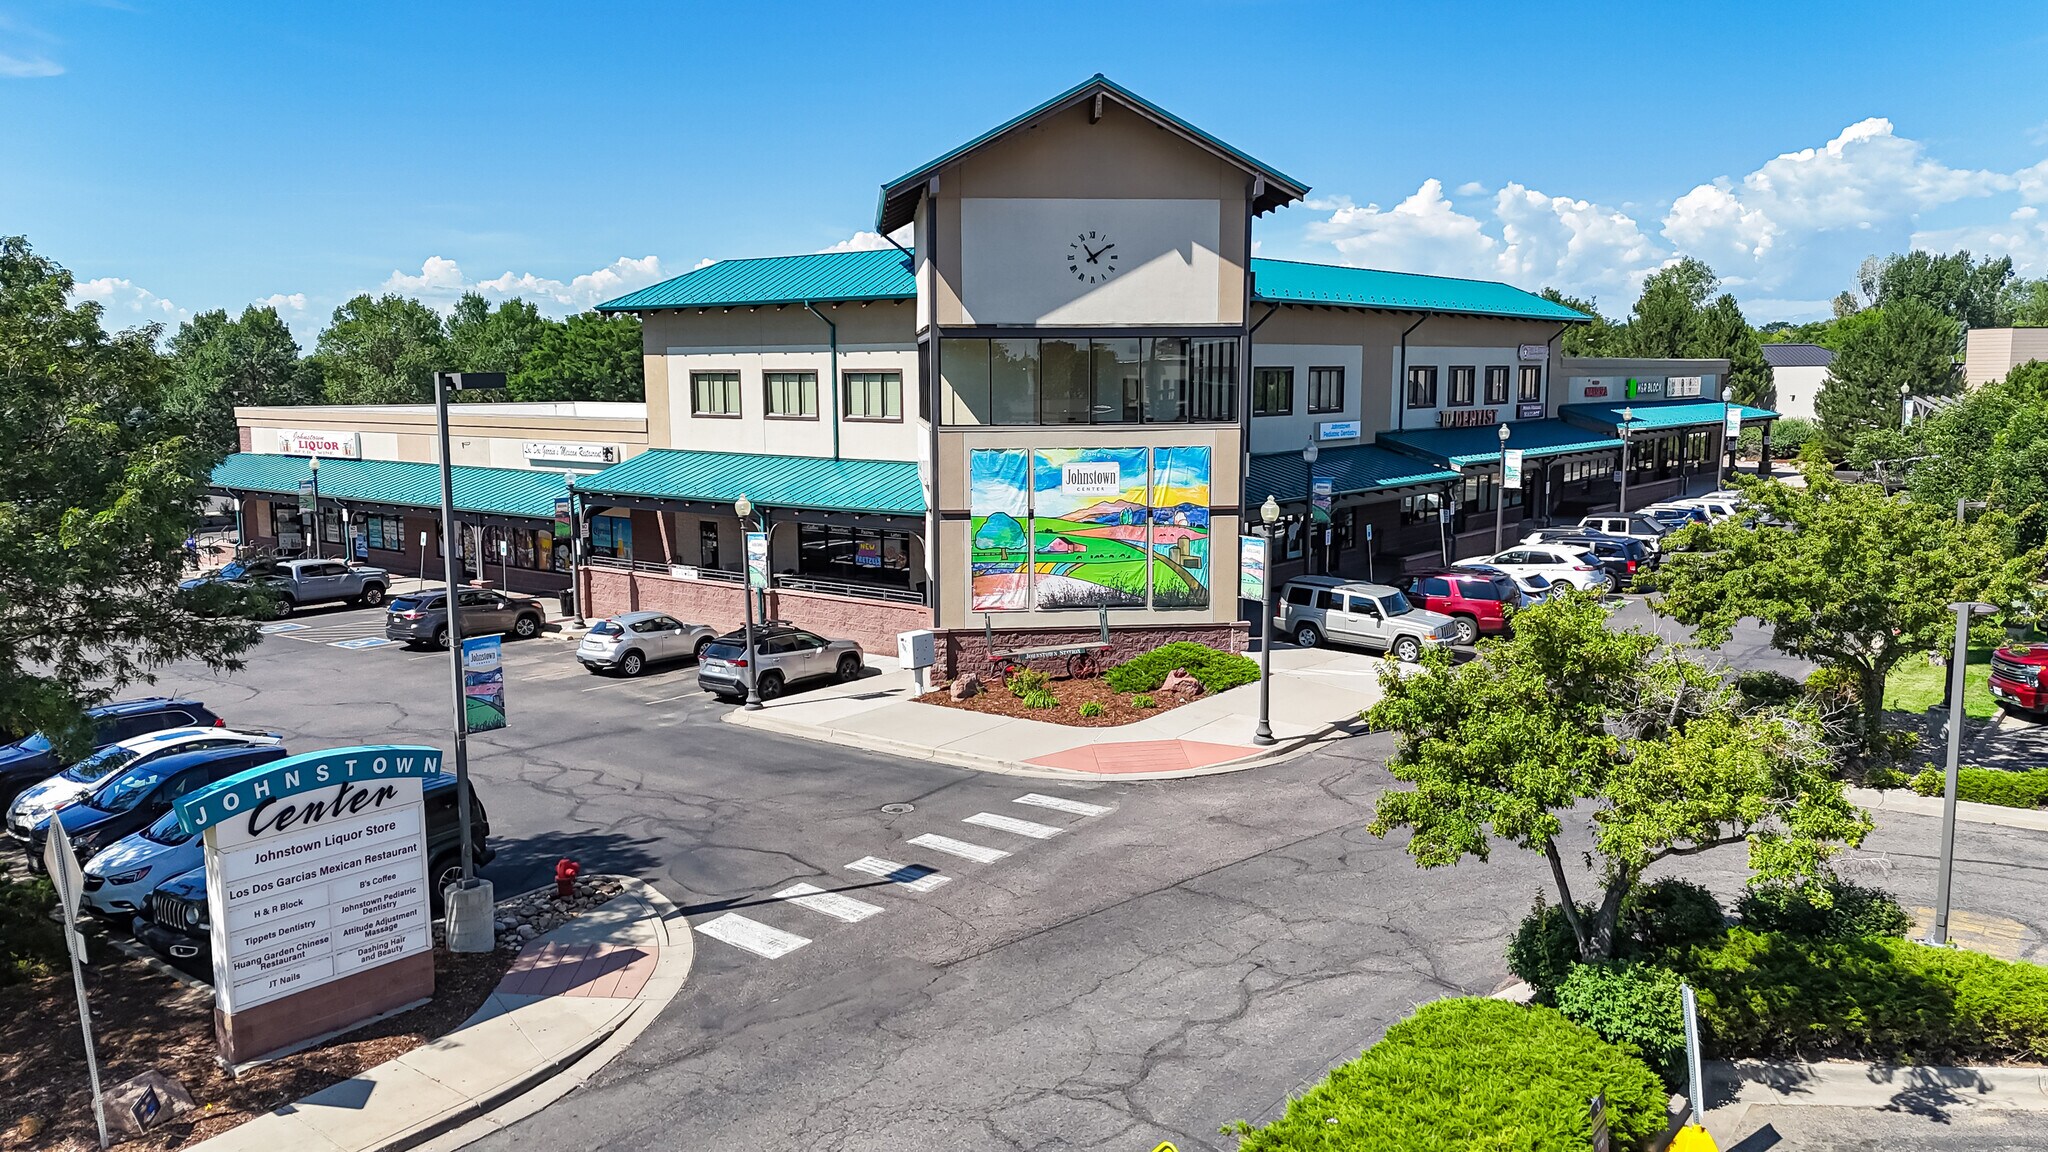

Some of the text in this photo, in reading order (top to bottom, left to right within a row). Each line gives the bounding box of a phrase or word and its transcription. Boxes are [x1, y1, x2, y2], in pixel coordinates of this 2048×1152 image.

[1455, 409, 1498, 427] DENTIST
[293, 431, 325, 442] Johnstown
[298, 440, 339, 452] LIQUOR
[1065, 469, 1116, 485] Johnstown
[860, 543, 875, 551] NEW
[471, 651, 496, 663] Johnstown
[195, 756, 438, 826] JOHNSTOWN
[248, 781, 398, 837] Center
[254, 820, 396, 865] Johnstown Liquor Store
[229, 843, 417, 900] Los Dos Garcias Mexican Restaurant
[359, 873, 397, 889] B's Coffee
[254, 898, 304, 919] H & R Block
[341, 887, 417, 914] Johnstown Pediatric
[362, 900, 398, 916] Dentistry
[342, 908, 418, 937] Attitude Adjustment
[364, 923, 398, 938] Massage
[244, 920, 316, 946] Tippets Dentistry
[233, 936, 330, 971] Huang Garden Chinese
[357, 936, 406, 957] Dashing Hair
[361, 945, 404, 963] and Beauty
[260, 950, 306, 970] Restaurant
[268, 973, 301, 989] JT Nails
